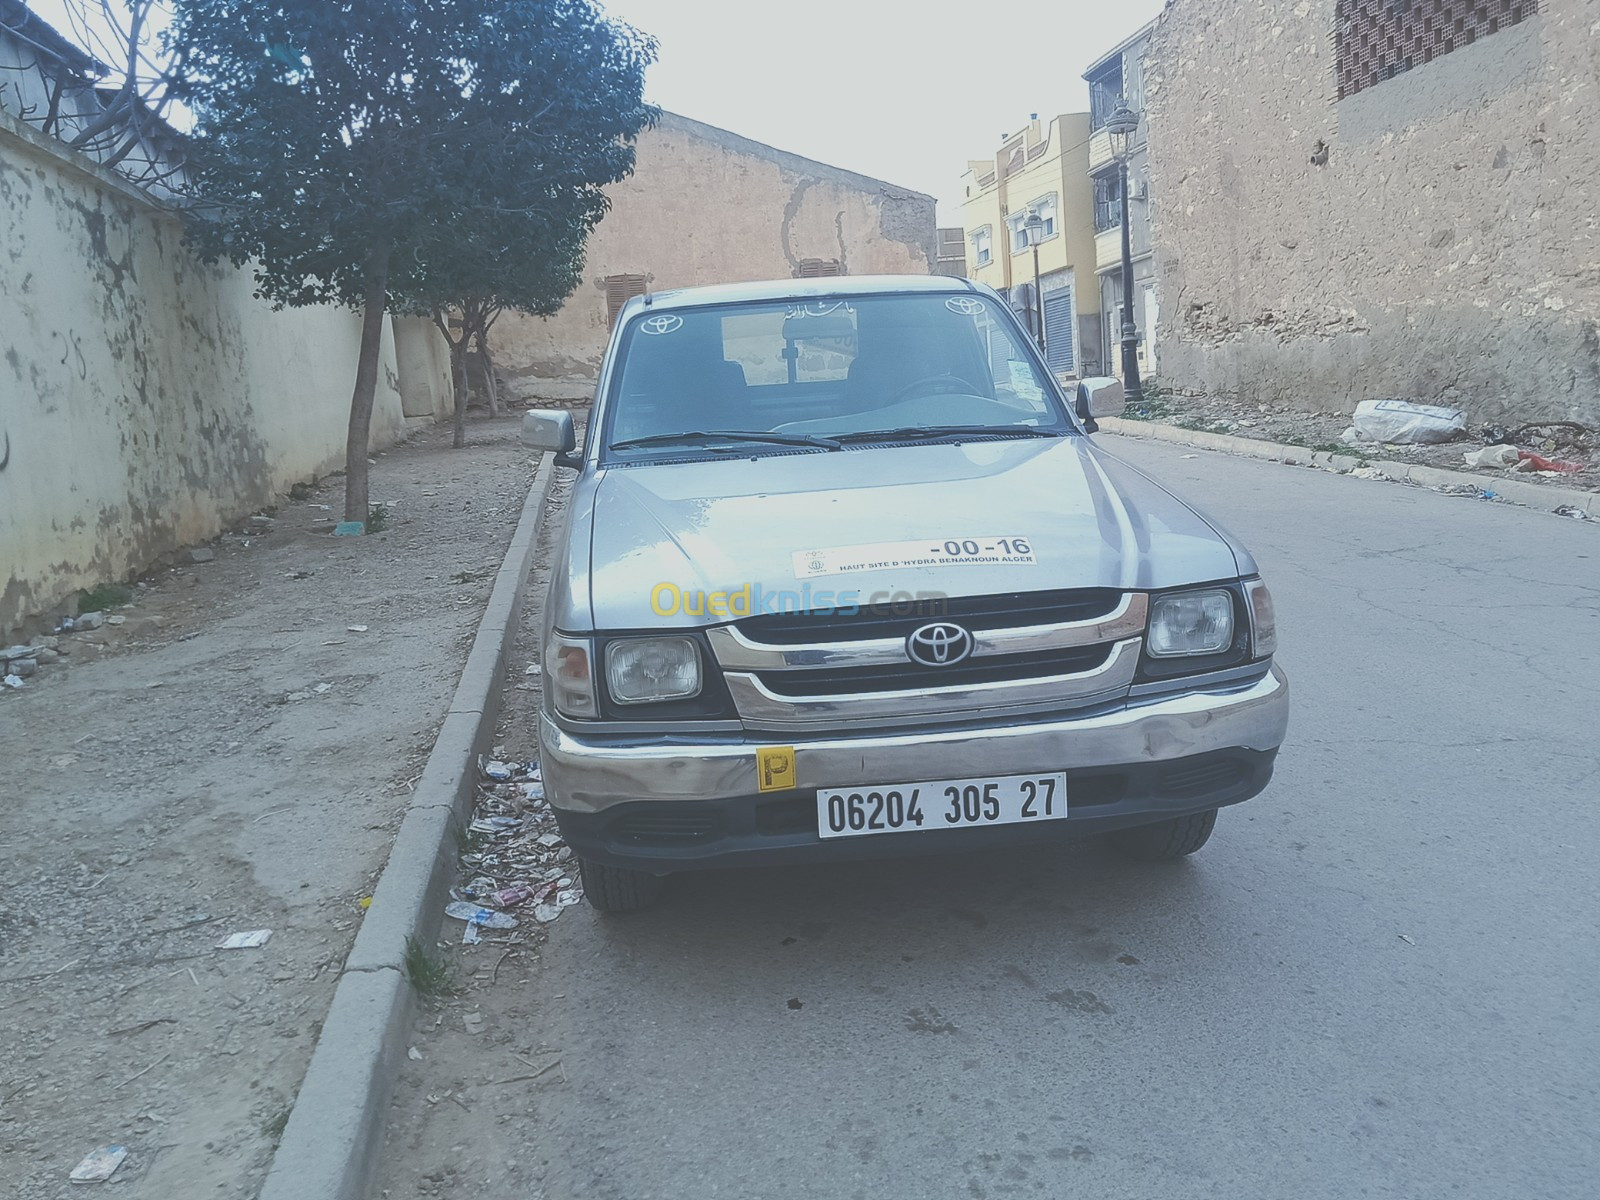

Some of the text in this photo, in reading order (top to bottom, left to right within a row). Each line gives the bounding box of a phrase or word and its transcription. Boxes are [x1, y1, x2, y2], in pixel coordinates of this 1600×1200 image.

[839, 563, 866, 571] HAUT
[868, 561, 890, 569] SITE
[940, 556, 999, 564] BENAKNOUN
[827, 779, 1057, 832] 06204 305 27
